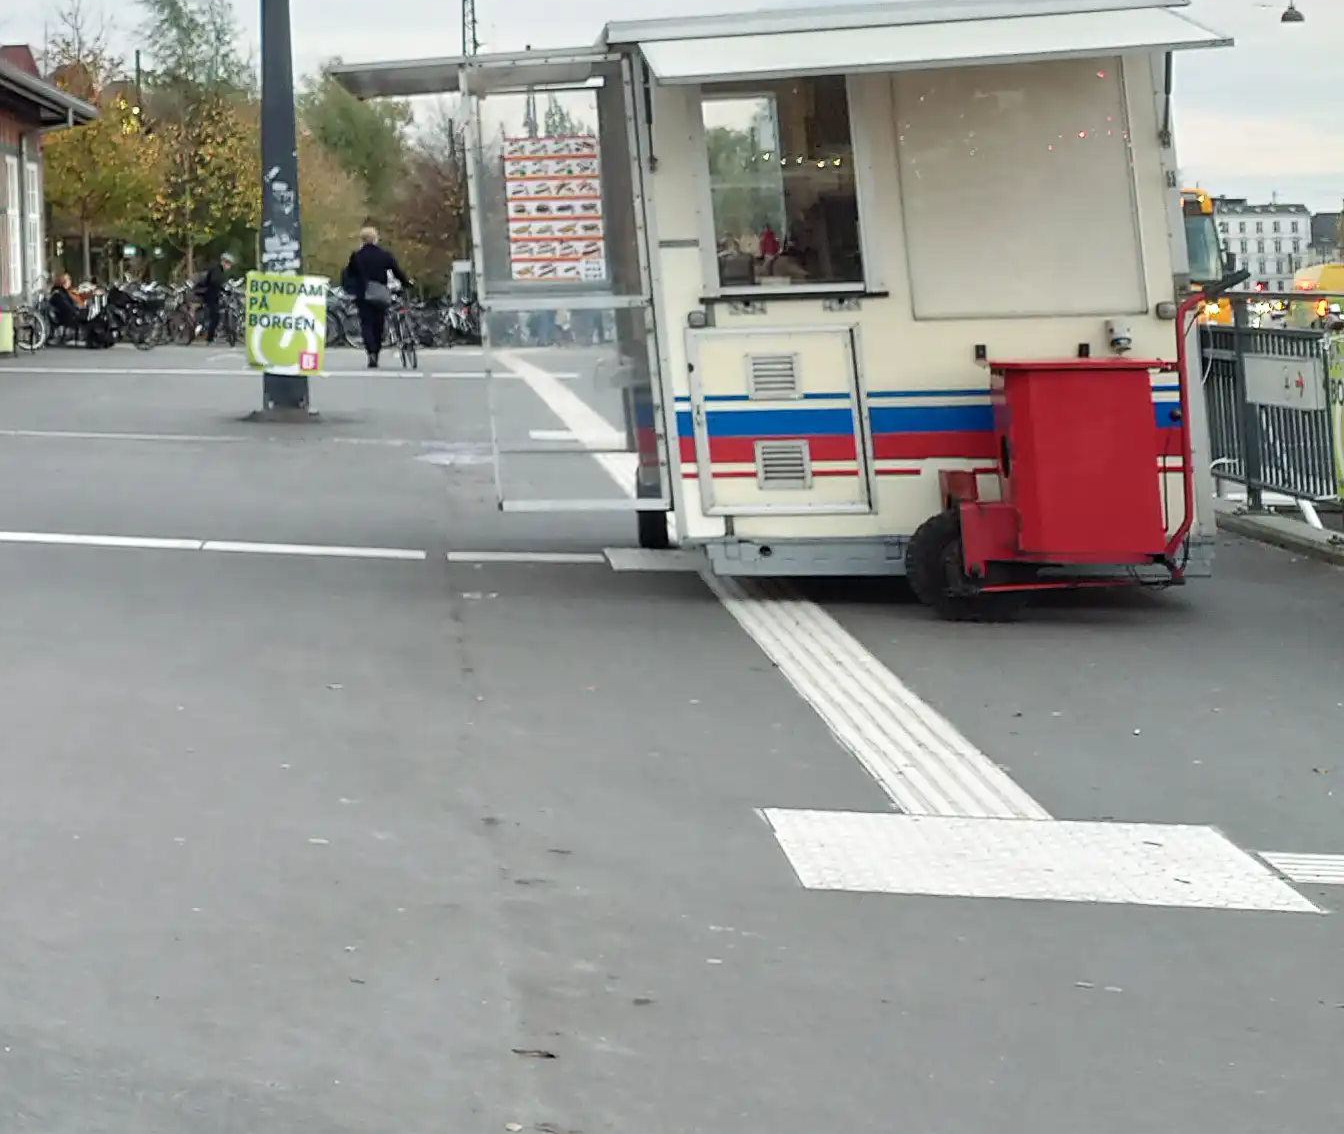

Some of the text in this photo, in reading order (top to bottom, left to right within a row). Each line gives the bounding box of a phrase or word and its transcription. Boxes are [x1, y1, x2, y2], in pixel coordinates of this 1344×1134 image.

[249, 279, 323, 297] BONDAM
[249, 295, 269, 311] PÅ
[248, 313, 315, 331] BORGEN
